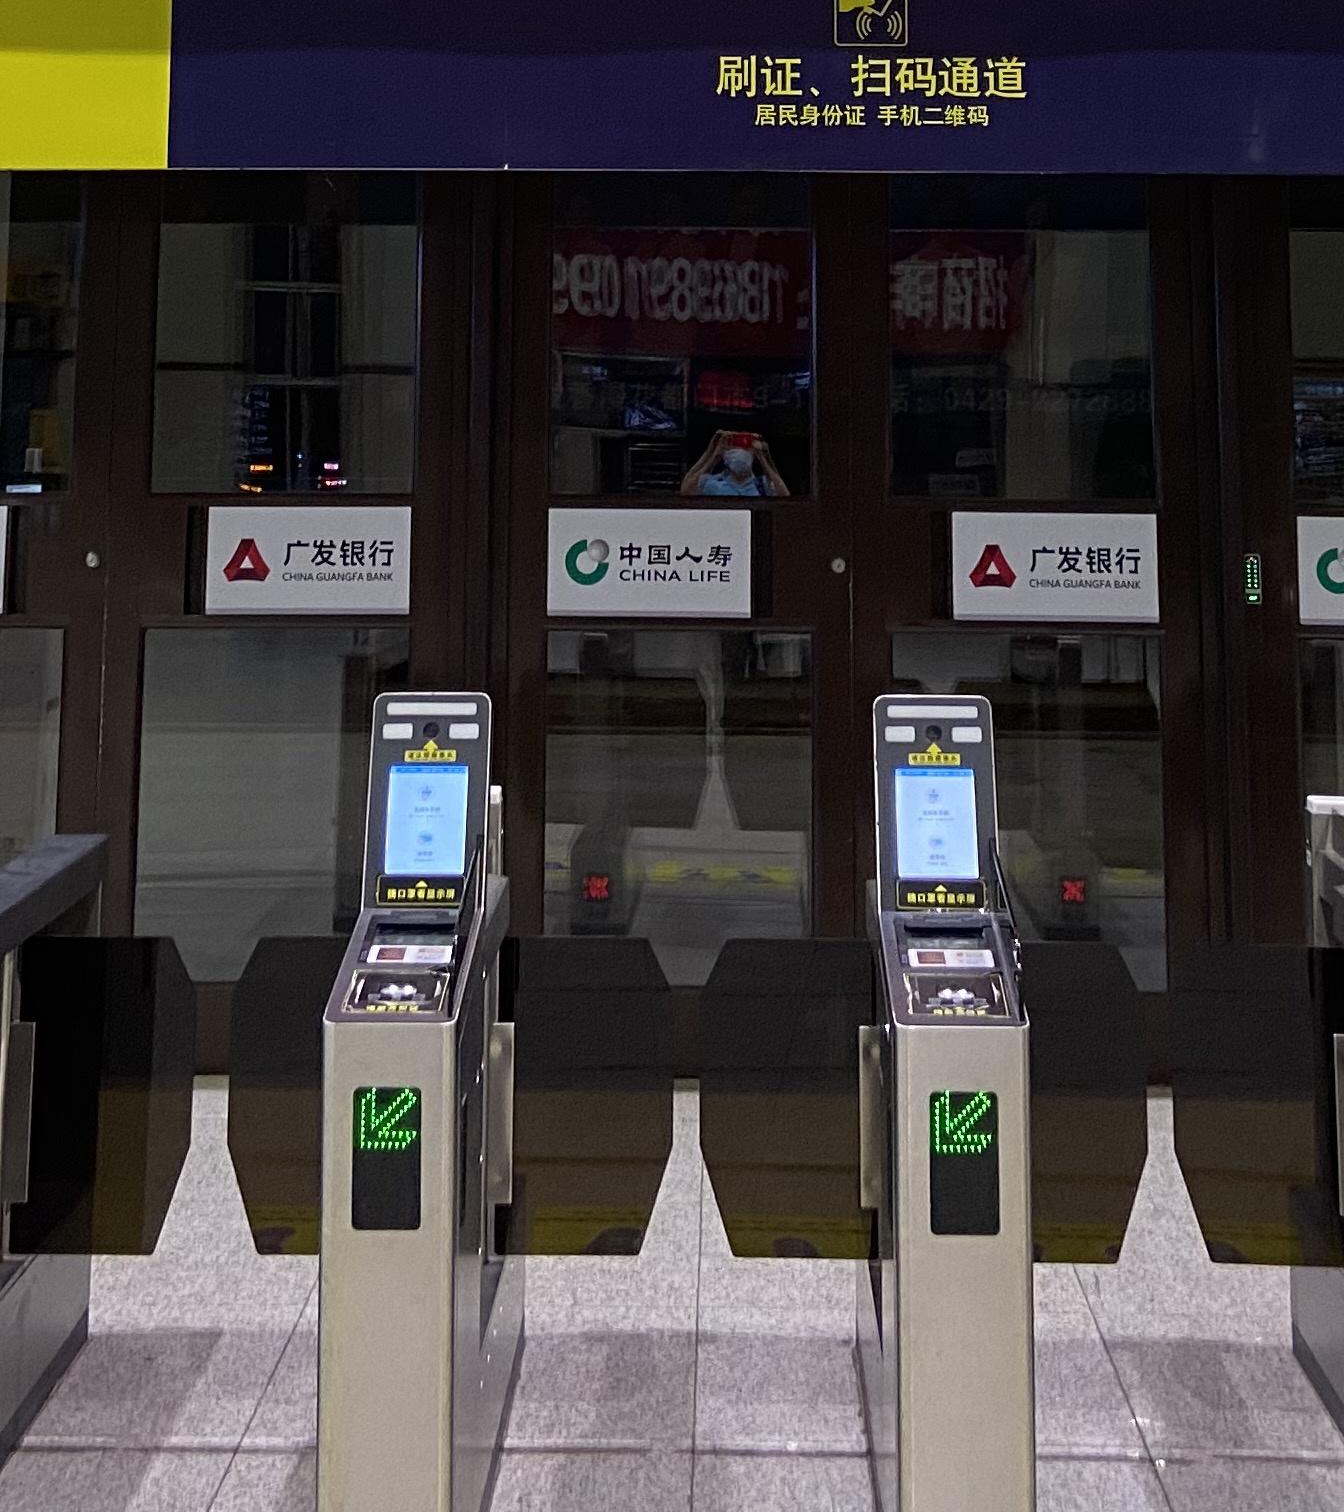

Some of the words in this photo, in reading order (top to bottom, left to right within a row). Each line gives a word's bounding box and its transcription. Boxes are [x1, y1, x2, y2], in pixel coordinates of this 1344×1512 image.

[716, 54, 1028, 99] 刷证、扫码通道
[754, 103, 867, 127] 居民身份证
[877, 104, 991, 127] 手机二维码
[283, 539, 395, 567] 广发银行
[619, 542, 734, 567] 中国人寿
[1030, 545, 1142, 574] 广发银行
[281, 572, 314, 582] CHINA
[316, 572, 364, 582] GUANGFA
[366, 572, 394, 582] BANK
[618, 569, 683, 583] CHINA
[688, 569, 732, 583] LIFE
[1028, 578, 1061, 589] CHINA
[1063, 579, 1112, 589] GUANGFA
[1113, 580, 1142, 590] BANK
